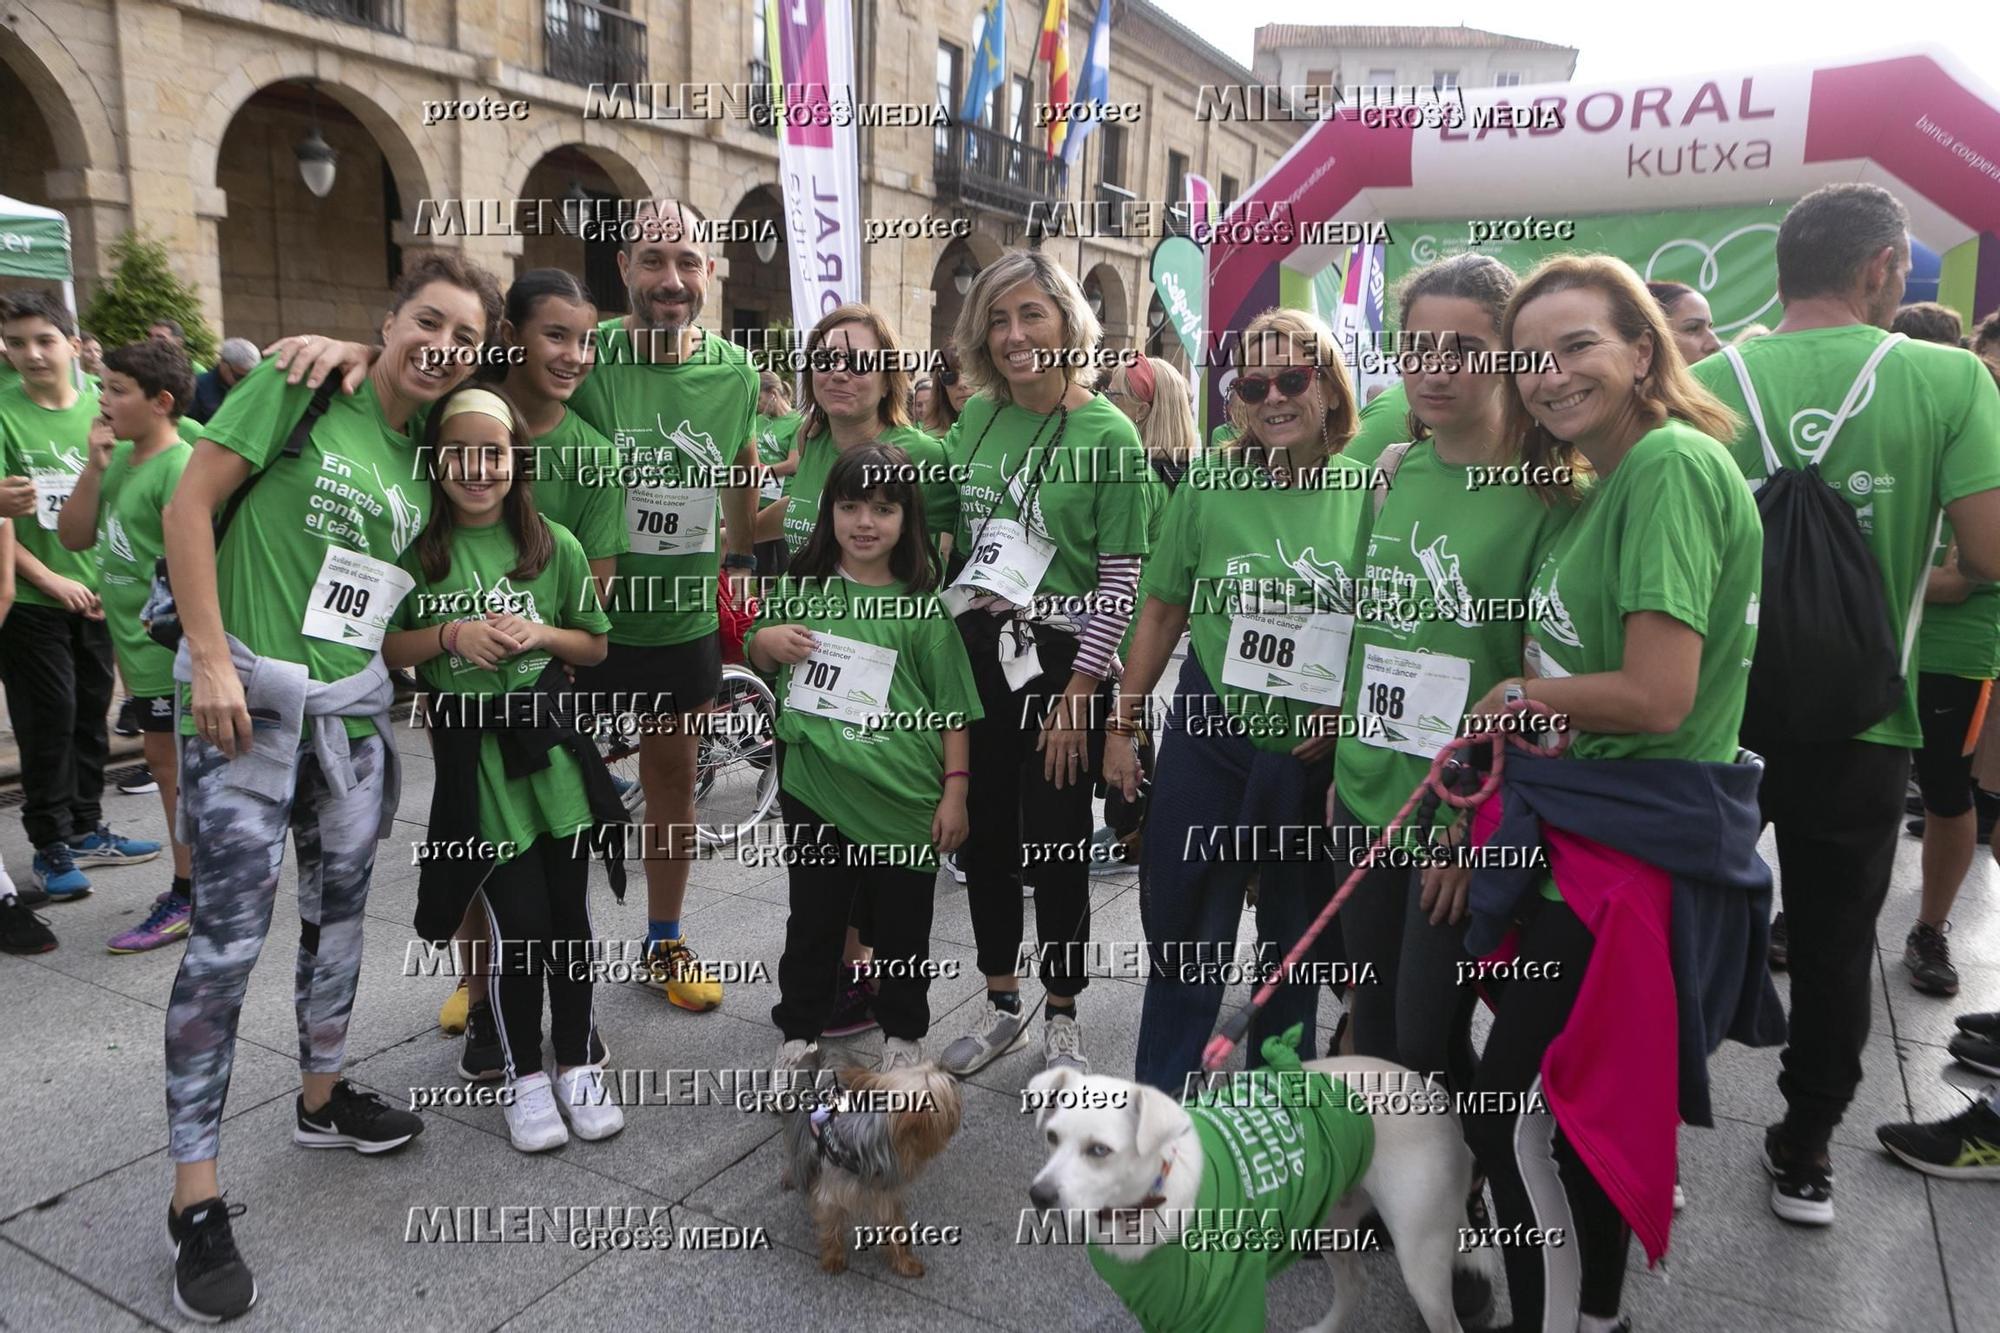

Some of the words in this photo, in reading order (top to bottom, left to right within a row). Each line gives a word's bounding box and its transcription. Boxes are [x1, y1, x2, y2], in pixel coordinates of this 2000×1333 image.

[1626, 137, 1772, 179] kutxa
[614, 432, 636, 448] En
[321, 454, 352, 478] En
[315, 475, 384, 518] marcha
[305, 513, 325, 529] el
[637, 508, 679, 535] 708
[1226, 561, 1250, 575] En
[1366, 564, 1416, 588] archa
[323, 579, 370, 618] 709
[1239, 629, 1296, 668] 808
[804, 659, 842, 691] 707
[1367, 682, 1406, 720] 188
